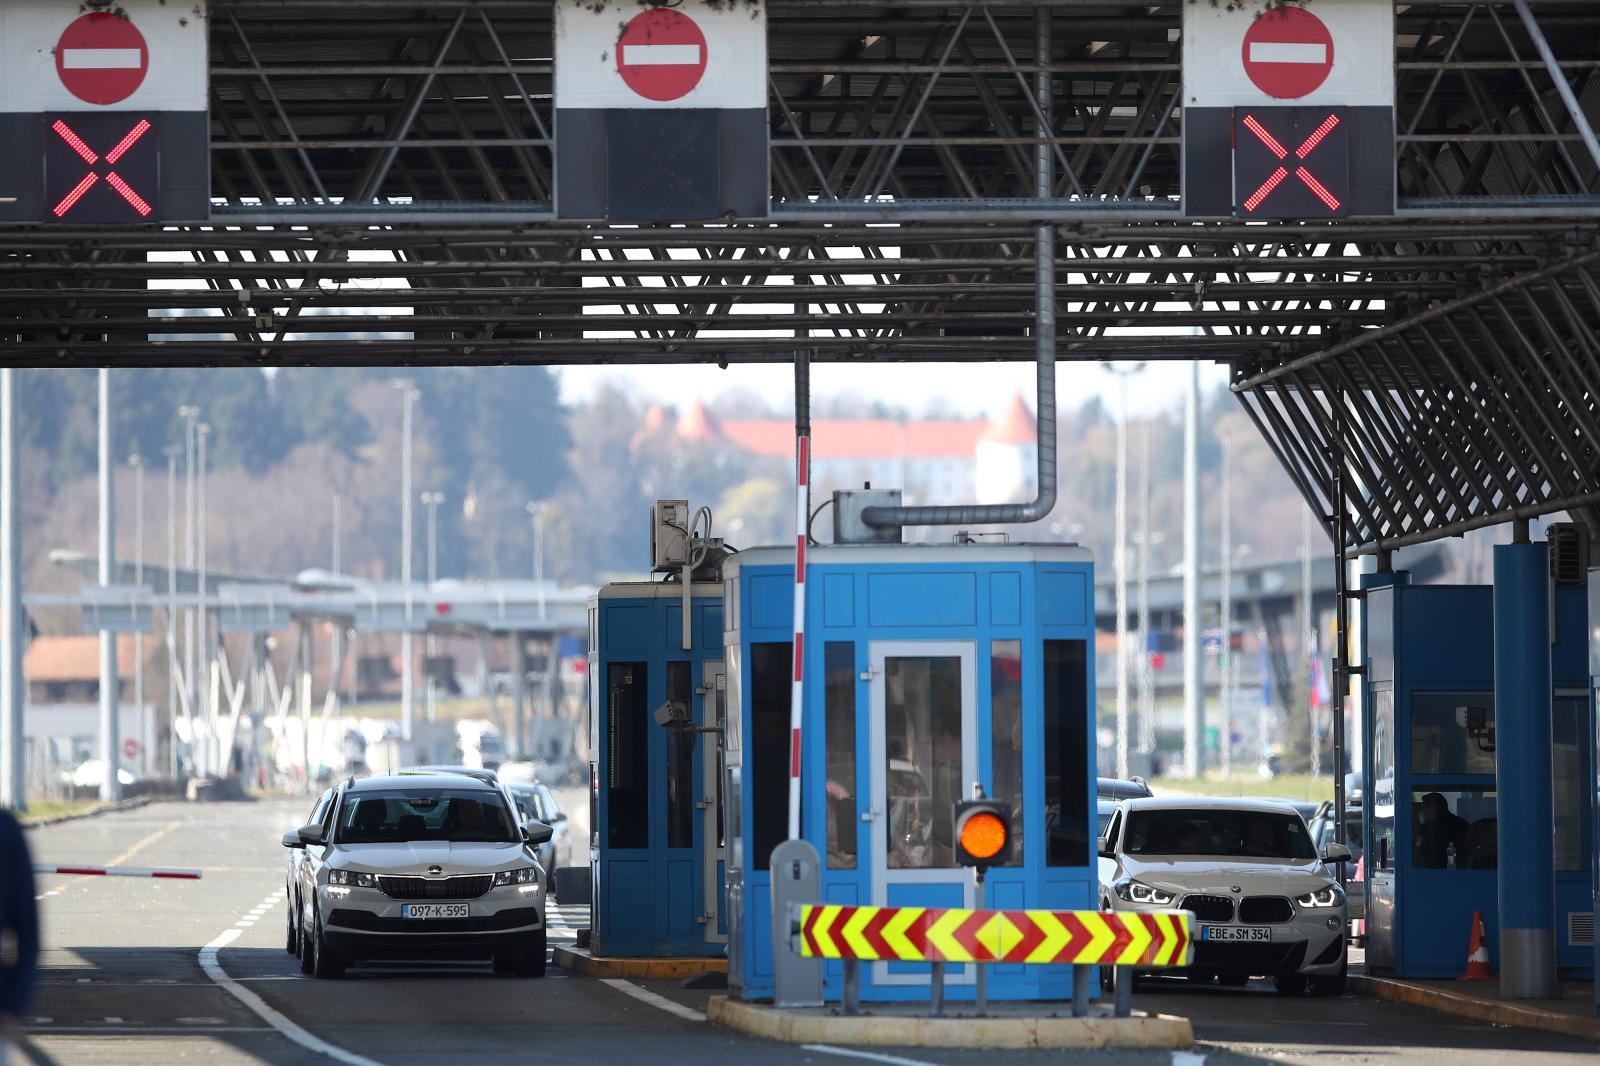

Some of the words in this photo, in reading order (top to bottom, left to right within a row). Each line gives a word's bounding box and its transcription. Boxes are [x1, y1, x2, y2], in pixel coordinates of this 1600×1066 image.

[410, 905, 467, 917] 097-K-595
[1209, 928, 1228, 939] EBE
[1251, 929, 1269, 941] 354
